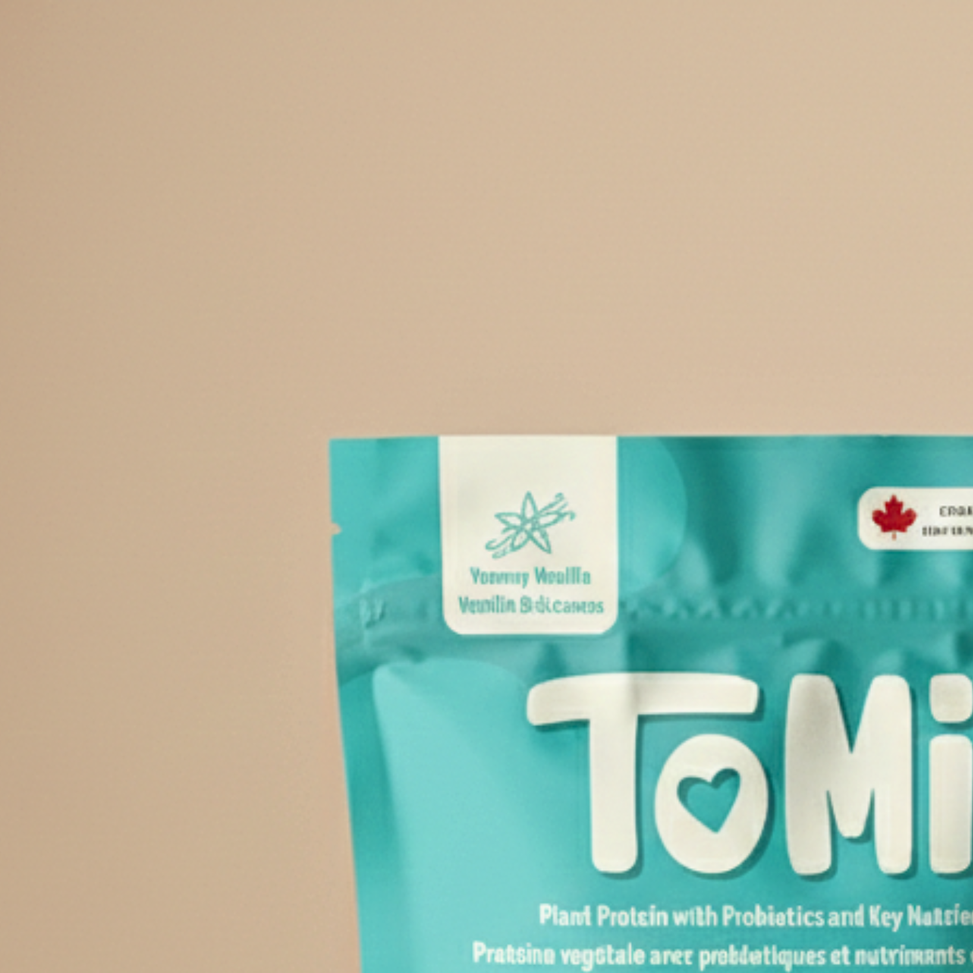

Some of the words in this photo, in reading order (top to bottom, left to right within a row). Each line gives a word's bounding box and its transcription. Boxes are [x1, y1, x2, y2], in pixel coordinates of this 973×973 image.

[828, 904, 865, 927] and
[869, 904, 904, 932] Key
[830, 945, 851, 965] et
